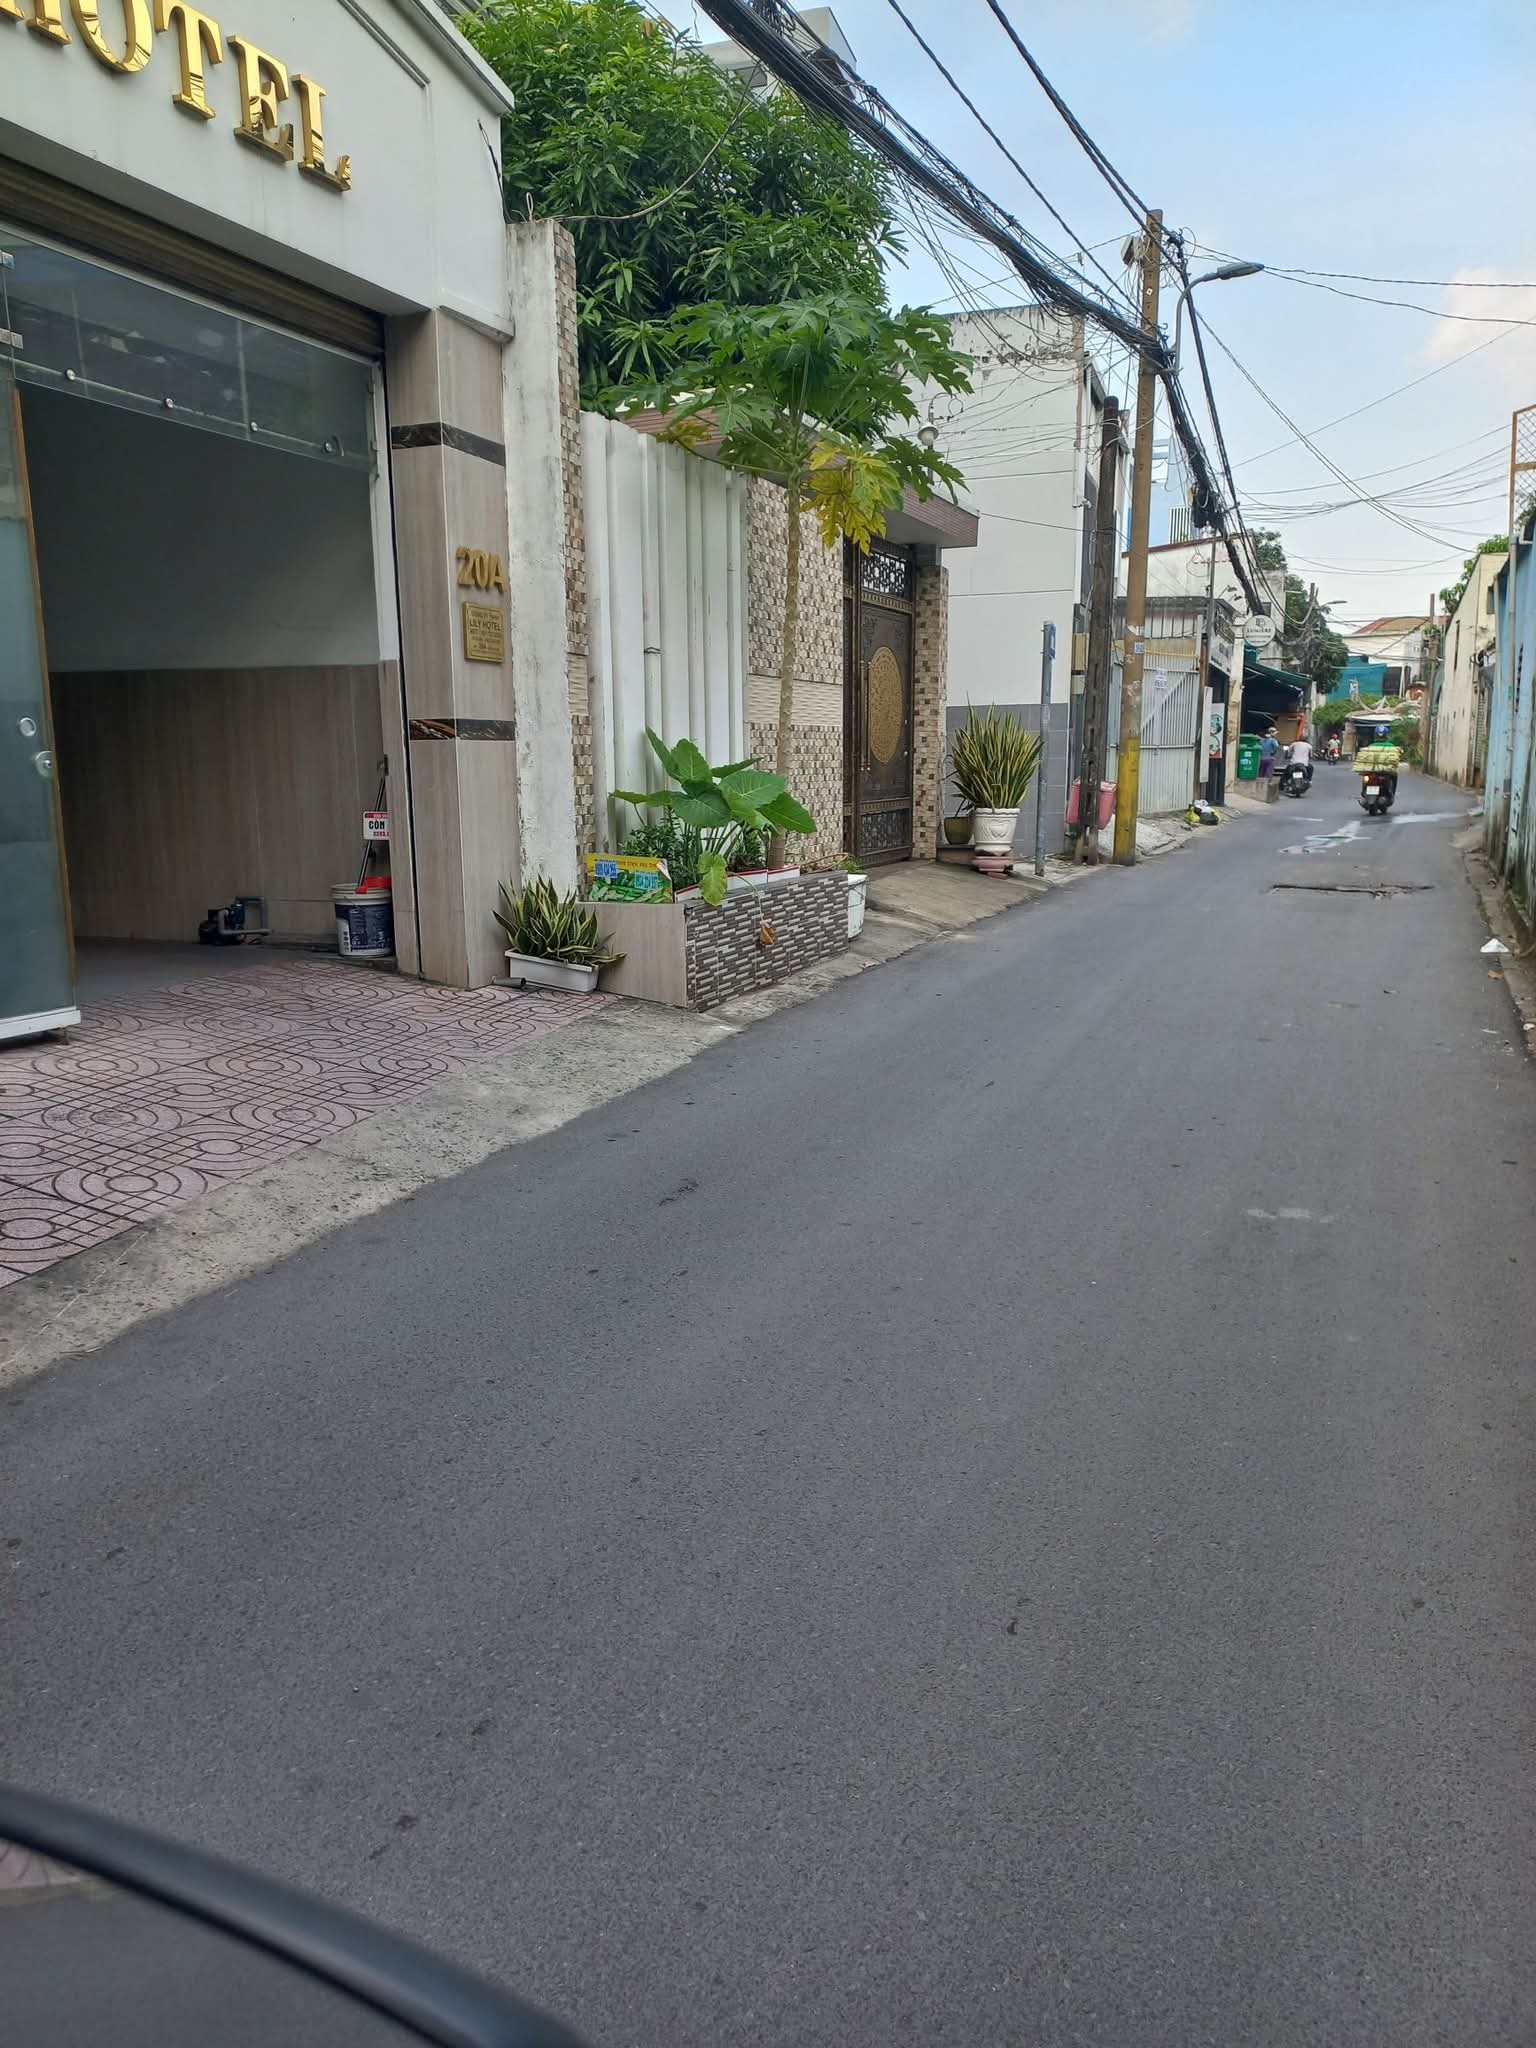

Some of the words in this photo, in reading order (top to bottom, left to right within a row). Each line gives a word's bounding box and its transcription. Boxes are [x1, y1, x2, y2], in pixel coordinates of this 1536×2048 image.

[0, 0, 352, 191] OTEL
[456, 545, 506, 592] 20A
[482, 620, 502, 632] HOTEL
